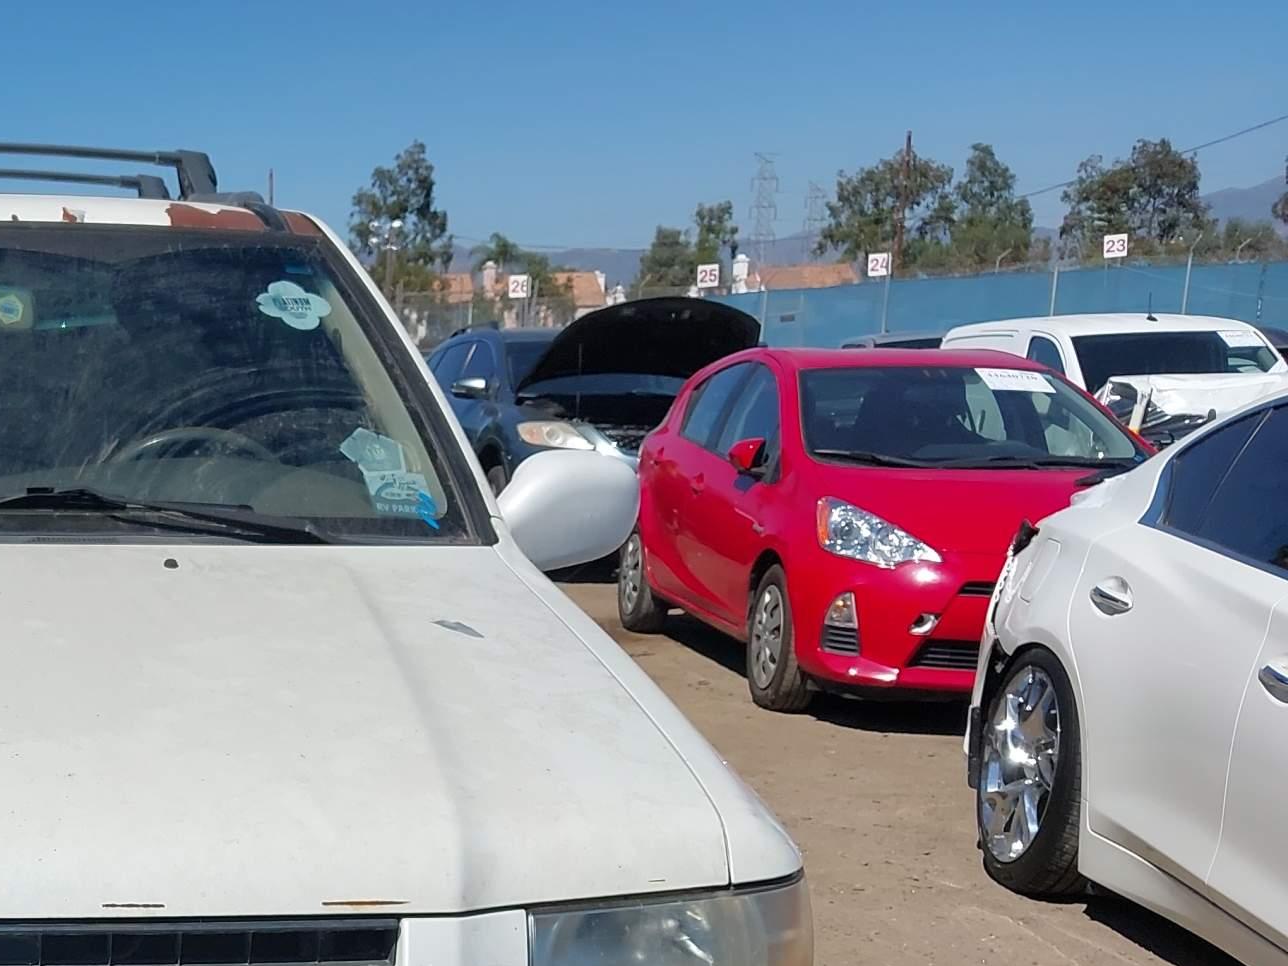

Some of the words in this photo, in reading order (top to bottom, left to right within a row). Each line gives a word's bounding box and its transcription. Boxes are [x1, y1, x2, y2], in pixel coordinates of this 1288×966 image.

[1105, 239, 1126, 253] 23
[870, 257, 889, 272] 24
[699, 269, 717, 283] 25
[376, 503, 389, 512] RV
